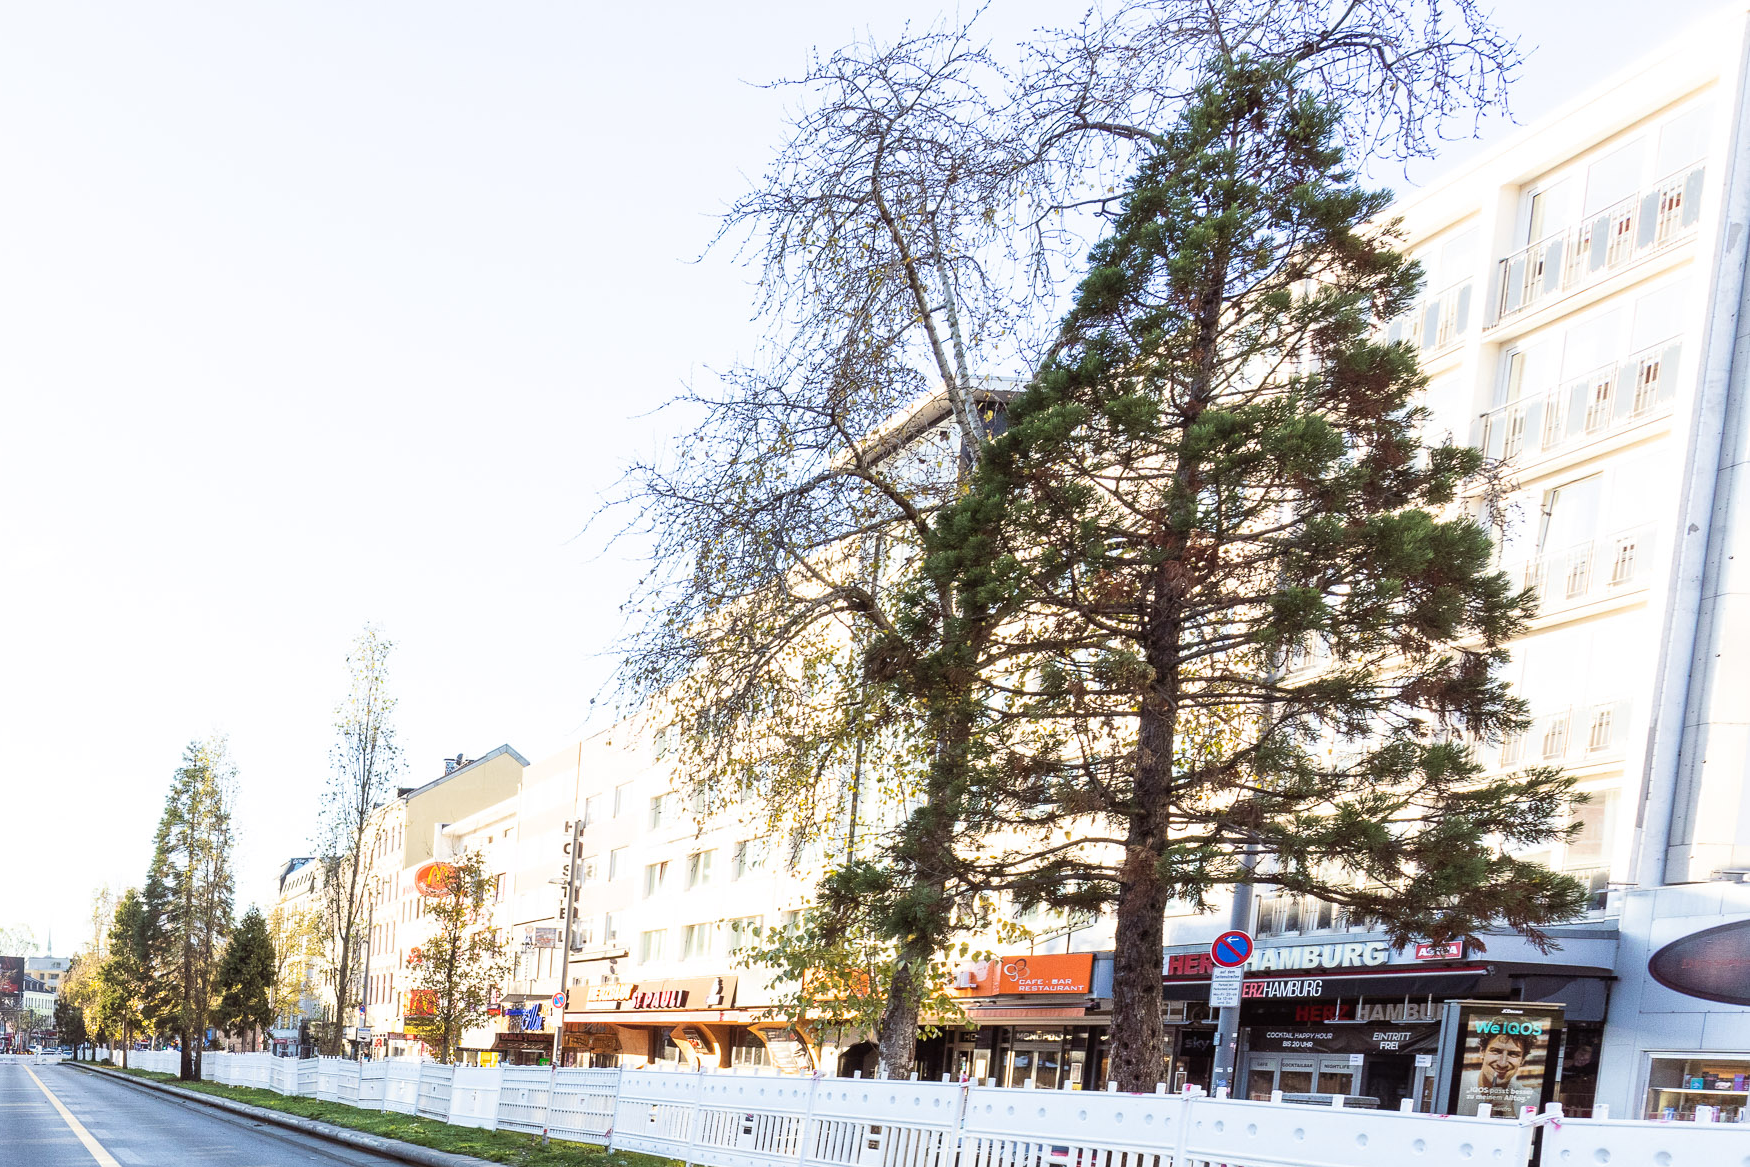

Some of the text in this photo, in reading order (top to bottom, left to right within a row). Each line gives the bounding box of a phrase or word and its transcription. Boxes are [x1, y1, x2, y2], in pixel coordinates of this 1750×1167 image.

[1168, 941, 1390, 975] HER HAMBURG
[1241, 979, 1323, 998] ERZHAMBURG
[643, 990, 683, 1008] PAULI
[1294, 1004, 1349, 1021] HERZ
[1474, 1020, 1500, 1034] We
[1372, 1032, 1412, 1041] EINTRITT
